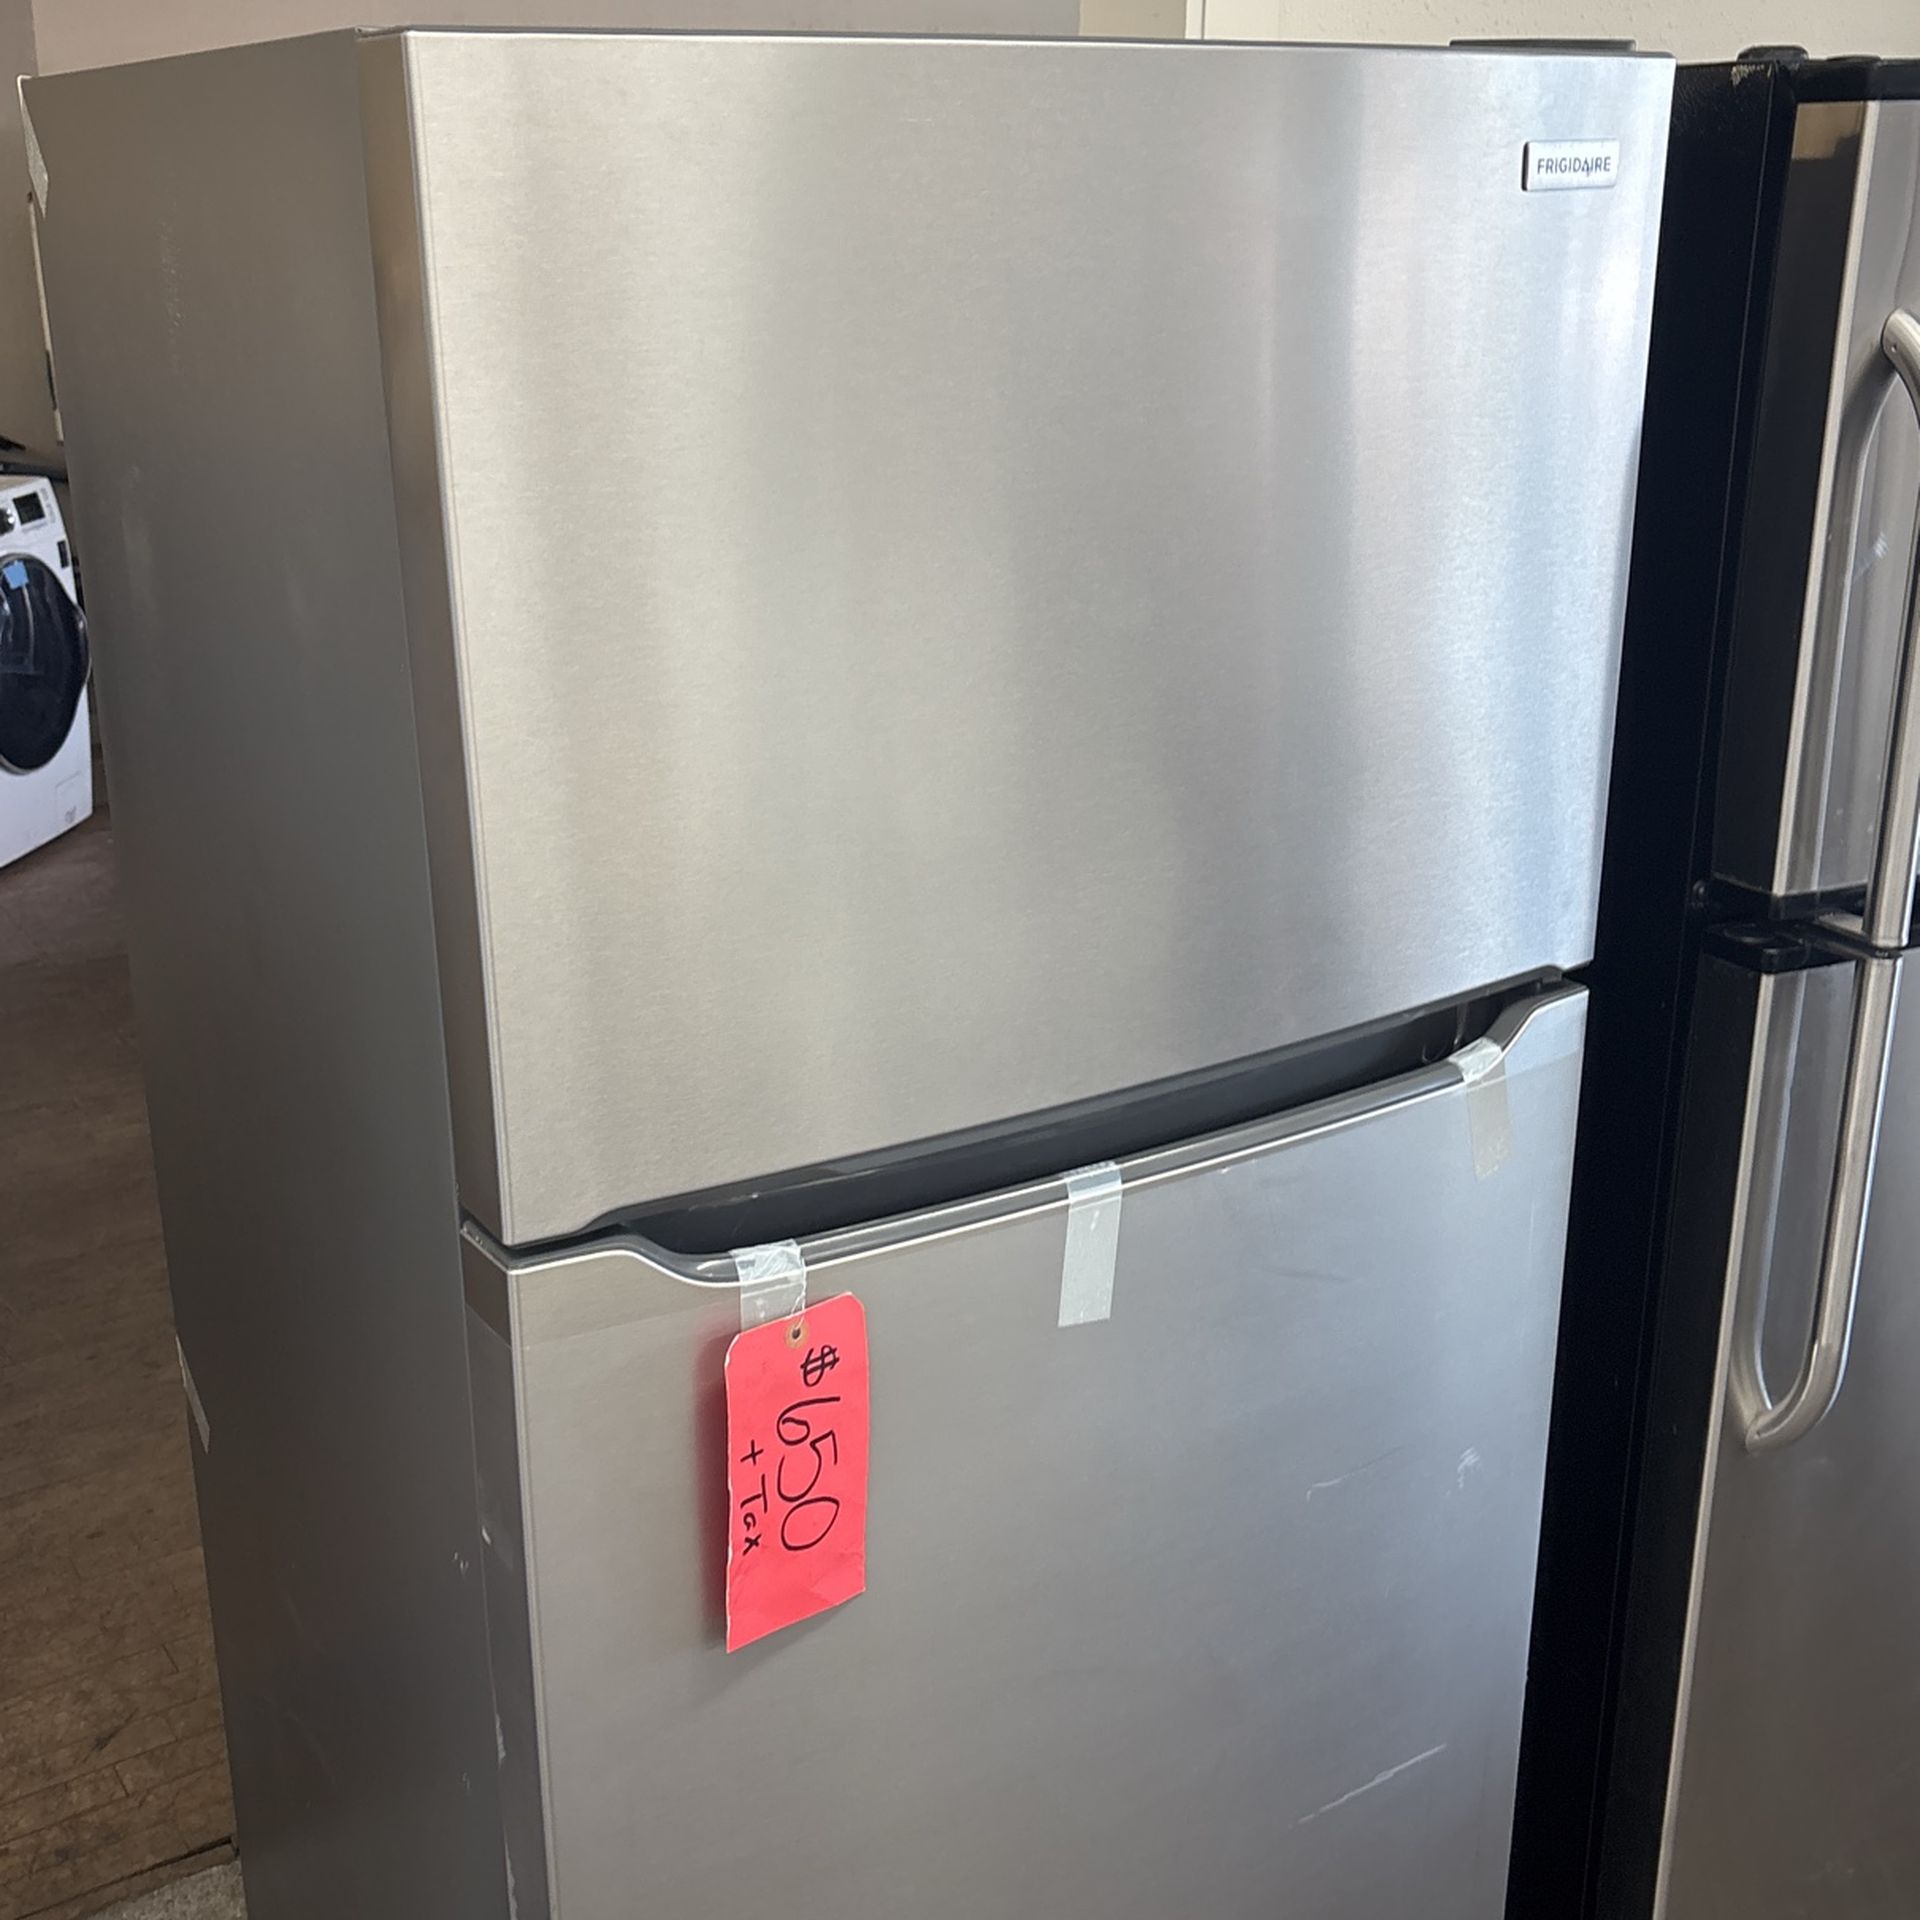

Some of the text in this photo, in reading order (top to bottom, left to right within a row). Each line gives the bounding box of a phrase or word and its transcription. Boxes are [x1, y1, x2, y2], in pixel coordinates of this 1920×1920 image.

[1536, 156, 1612, 177] FRIGIDAIRE
[776, 1345, 841, 1552] $650
[740, 1474, 768, 1555] Tax
